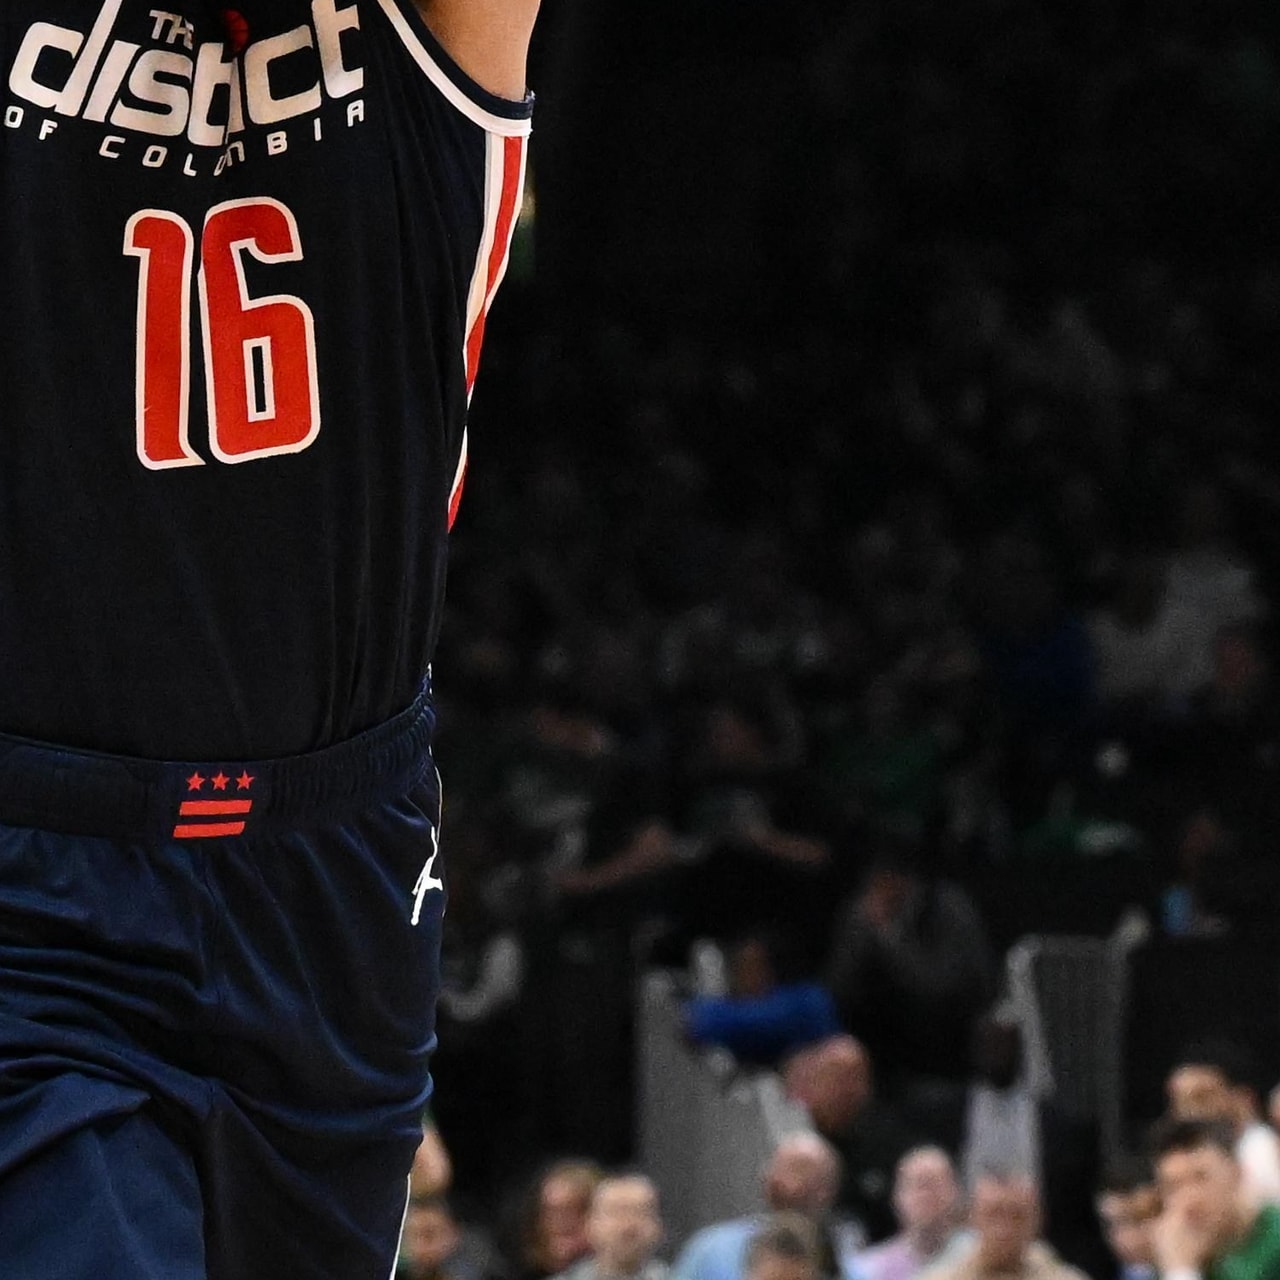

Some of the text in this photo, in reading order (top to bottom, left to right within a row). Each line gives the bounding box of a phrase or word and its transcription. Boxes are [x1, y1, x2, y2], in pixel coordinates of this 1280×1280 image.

[149, 9, 195, 50] TH
[4, 105, 58, 141] OF
[122, 196, 322, 471] 16
